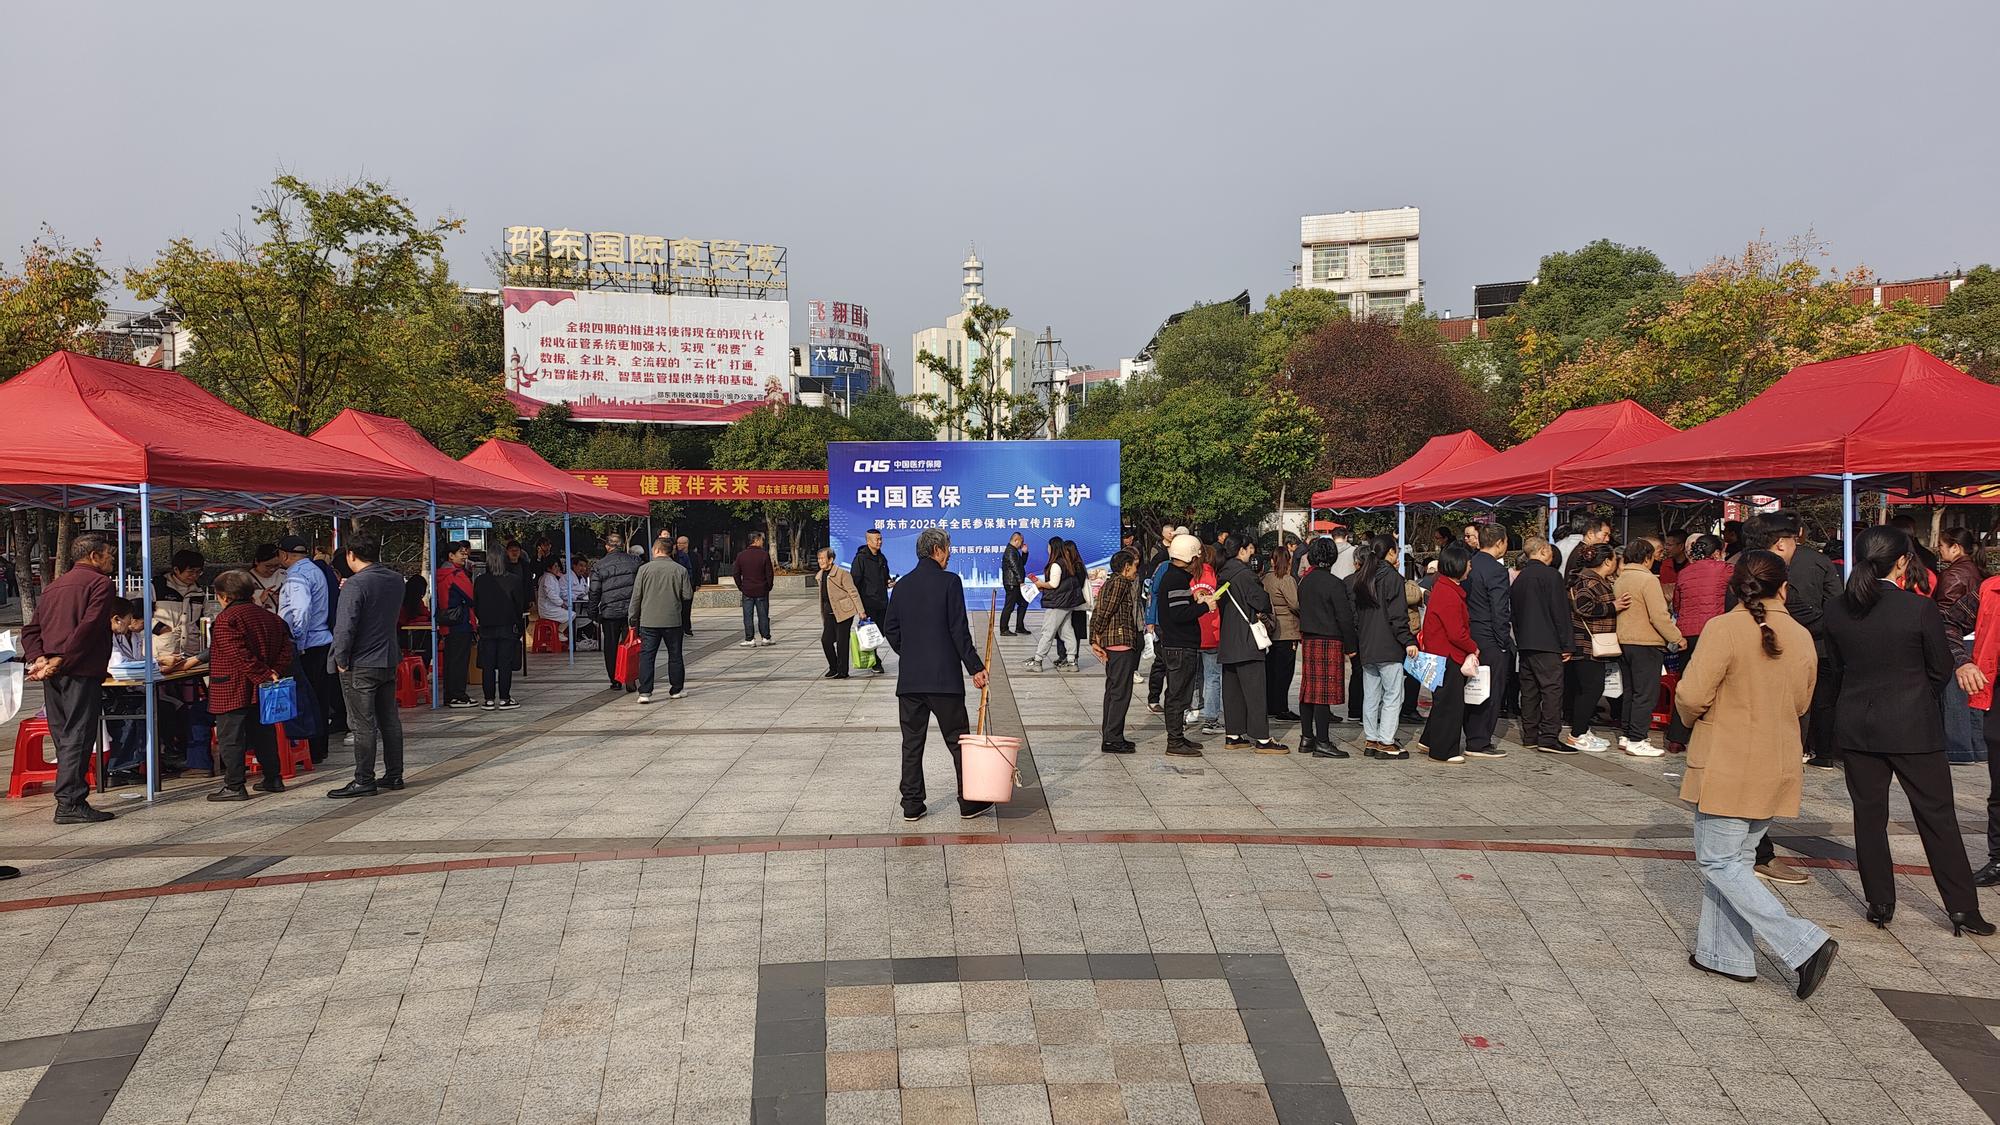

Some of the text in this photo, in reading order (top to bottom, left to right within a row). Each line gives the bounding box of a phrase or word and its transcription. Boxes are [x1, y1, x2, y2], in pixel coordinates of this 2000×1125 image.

[507, 226, 780, 276] 邵东国际商贸城
[566, 321, 765, 340] 金税四期的推进将使得现在的现代化
[815, 346, 857, 363] 大城小爱
[854, 459, 942, 473] CHS 中国医疗保障
[640, 474, 750, 495] 健康伴未来
[757, 484, 819, 495] 邵东市医疗保障局
[857, 484, 1091, 509] 中国医保 一生守护
[874, 517, 1075, 530] 邵东市2025年全民参保集中宣传月活动
[949, 545, 1006, 554] 东市医疗保障局
